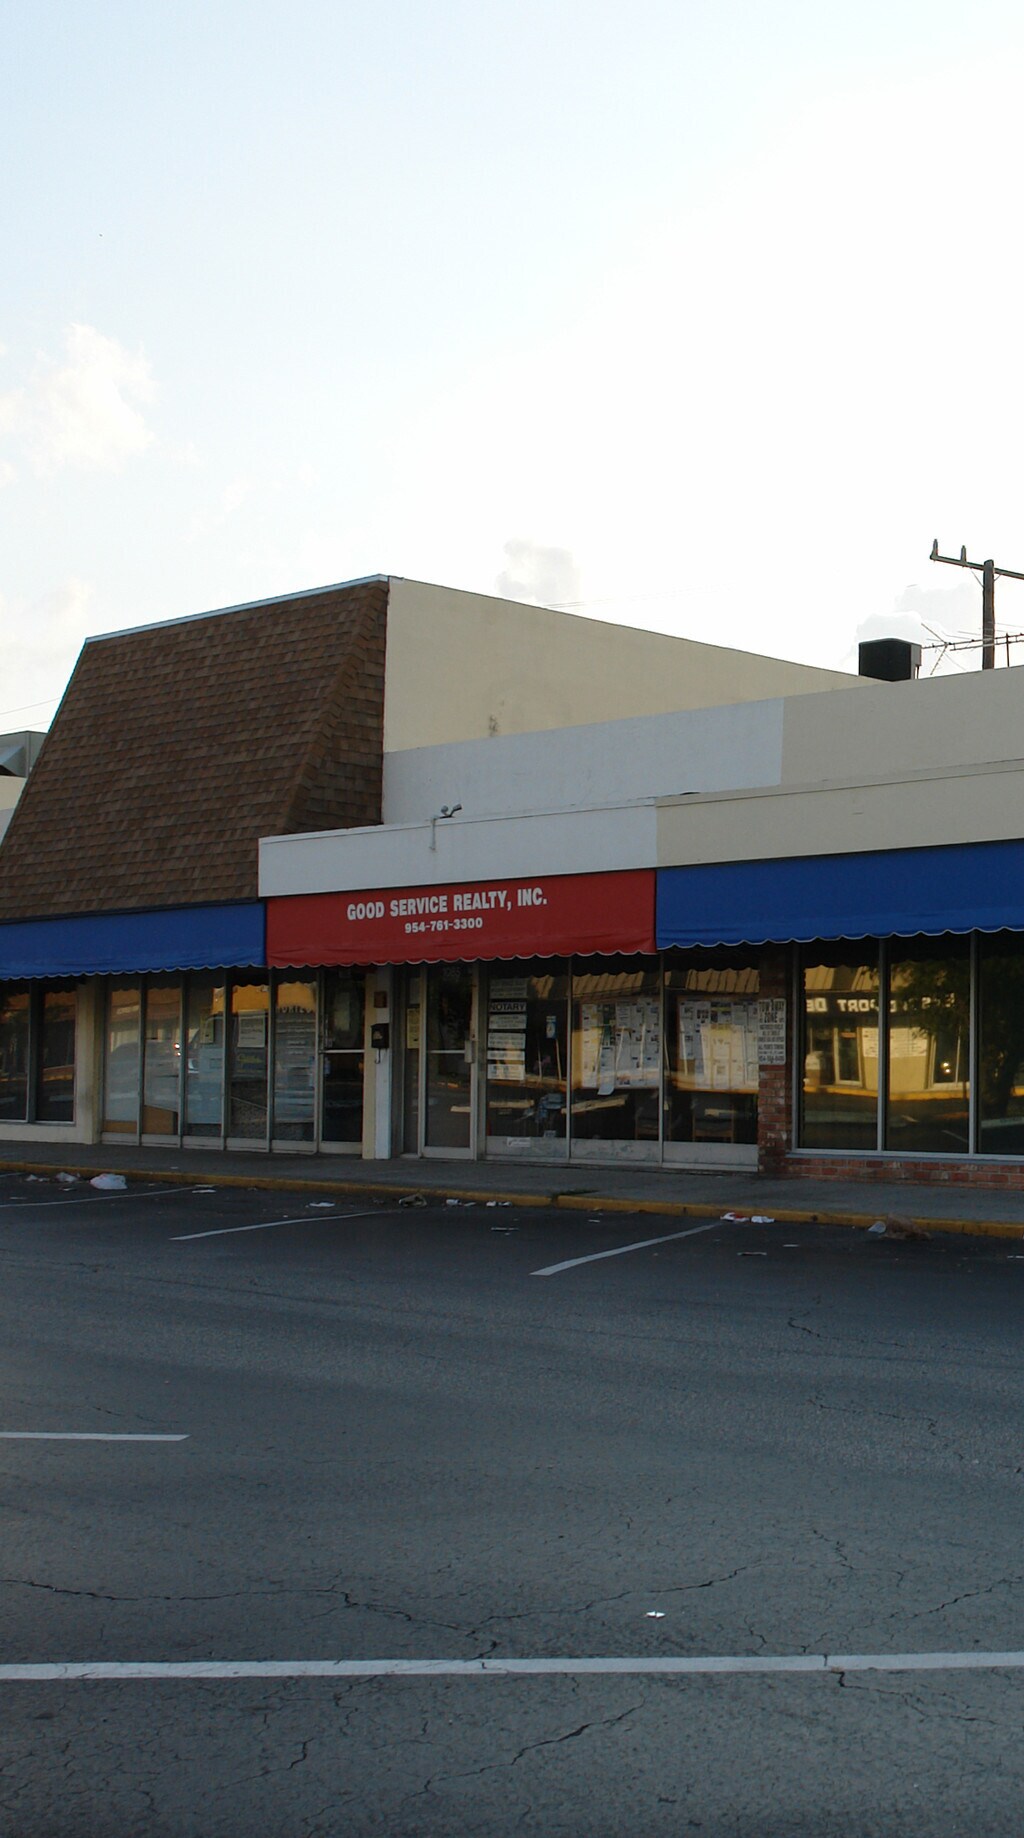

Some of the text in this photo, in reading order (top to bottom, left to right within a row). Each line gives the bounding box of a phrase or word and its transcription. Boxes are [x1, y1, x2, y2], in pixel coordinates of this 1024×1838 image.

[347, 887, 548, 920] GOOD SERVICE REALTY, INC.
[404, 917, 483, 933] 954-761-3300
[490, 1003, 525, 1011] NOTARY
